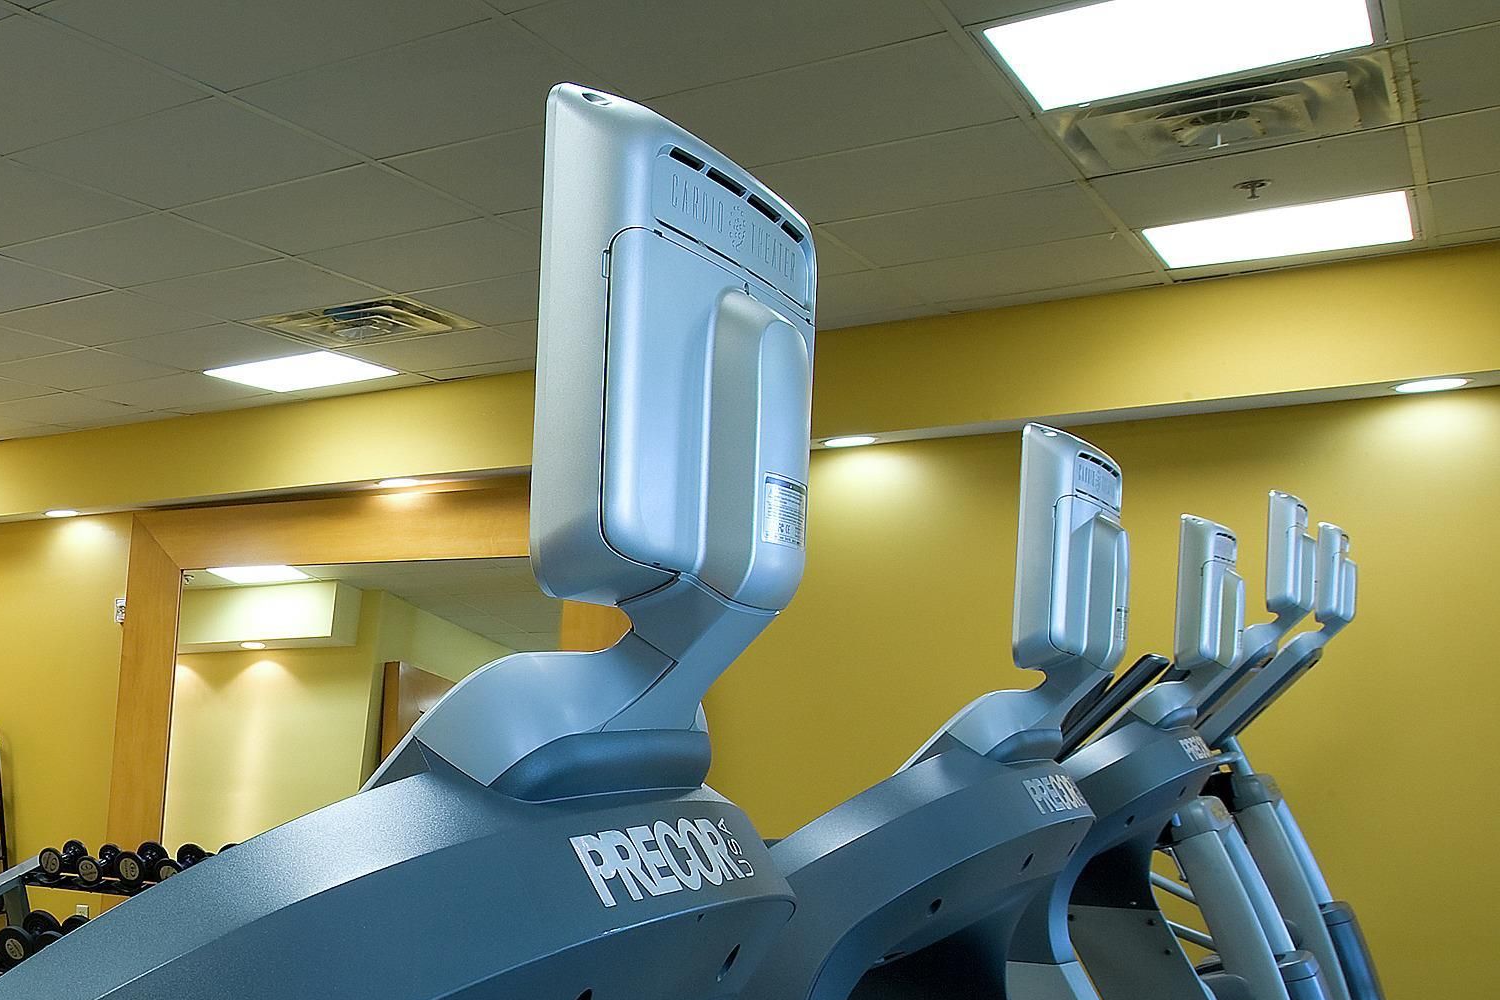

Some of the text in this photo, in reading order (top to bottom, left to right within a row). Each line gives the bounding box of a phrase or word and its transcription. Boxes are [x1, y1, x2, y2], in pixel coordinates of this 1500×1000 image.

[671, 173, 796, 282] CARDIO THEATER
[569, 816, 755, 908] PRECOR USA
